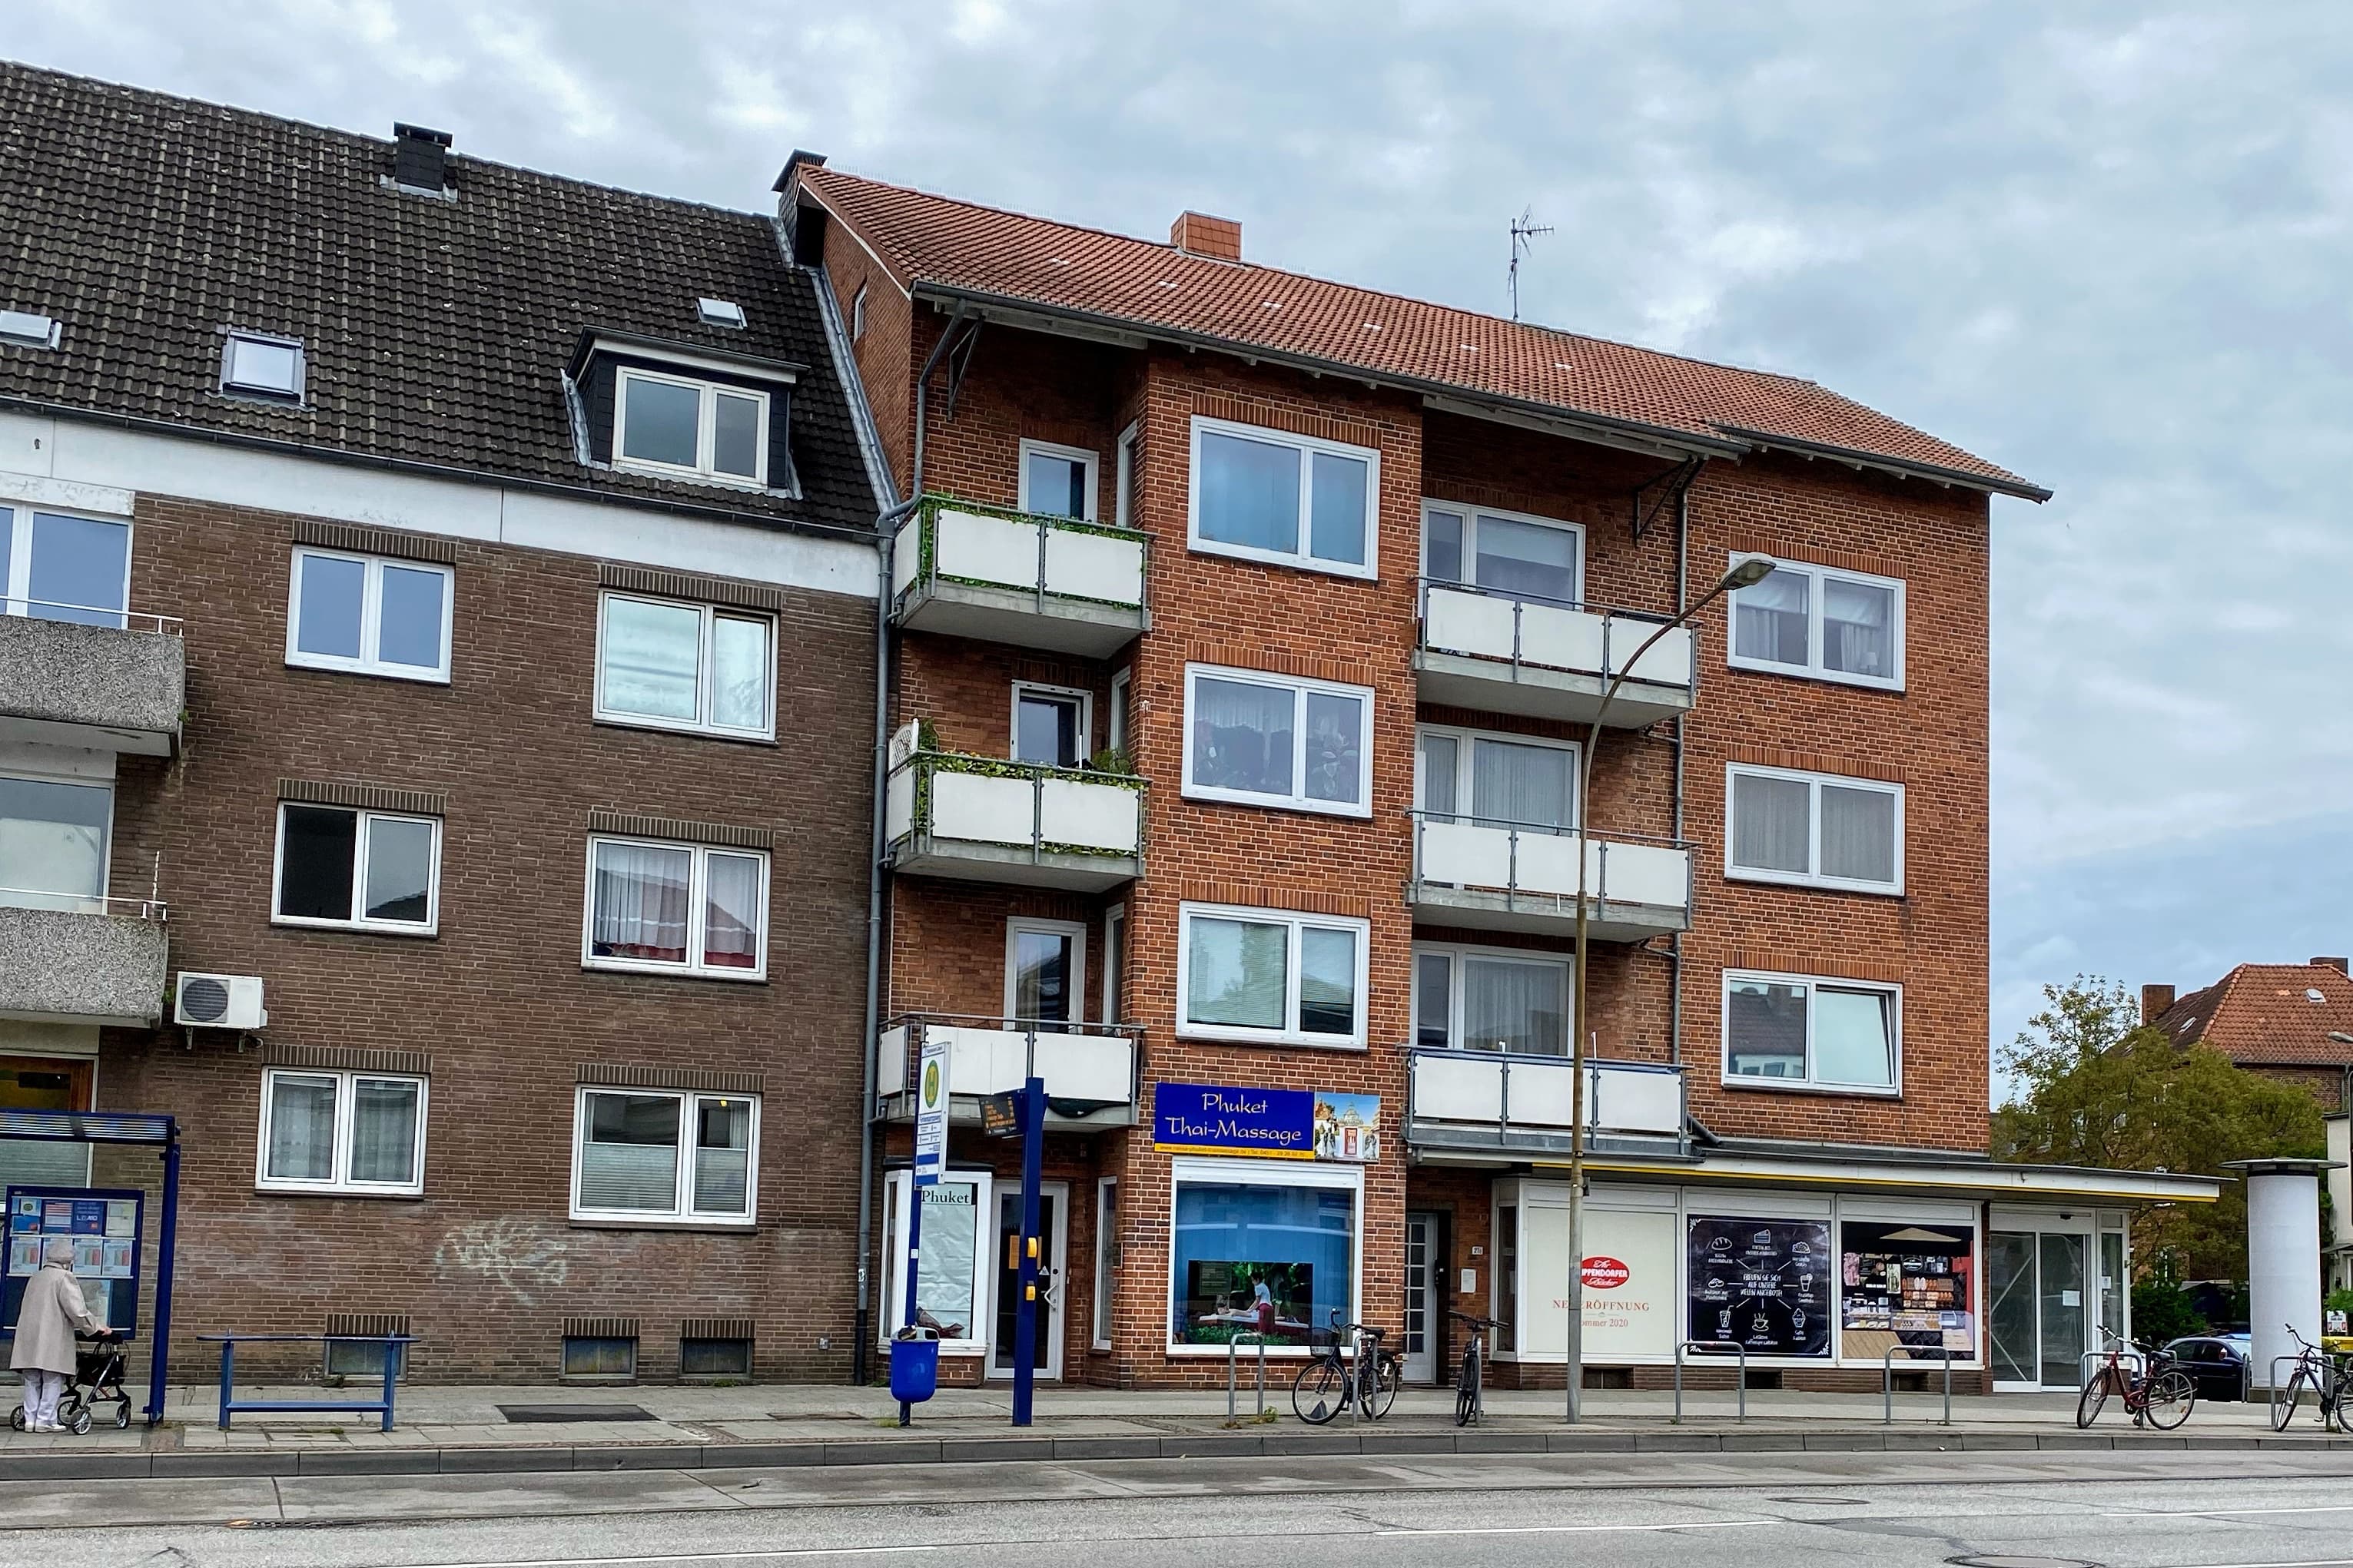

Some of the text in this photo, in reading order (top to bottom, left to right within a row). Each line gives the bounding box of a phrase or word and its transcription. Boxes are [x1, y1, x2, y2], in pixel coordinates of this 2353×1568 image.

[1202, 1092, 1269, 1114] Phuket
[1165, 1116, 1303, 1146] Thai-Massage
[921, 1189, 970, 1204] Phuket
[1553, 1299, 1650, 1311] NERÖFFNUNG
[1609, 1318, 1628, 1328] 2020
